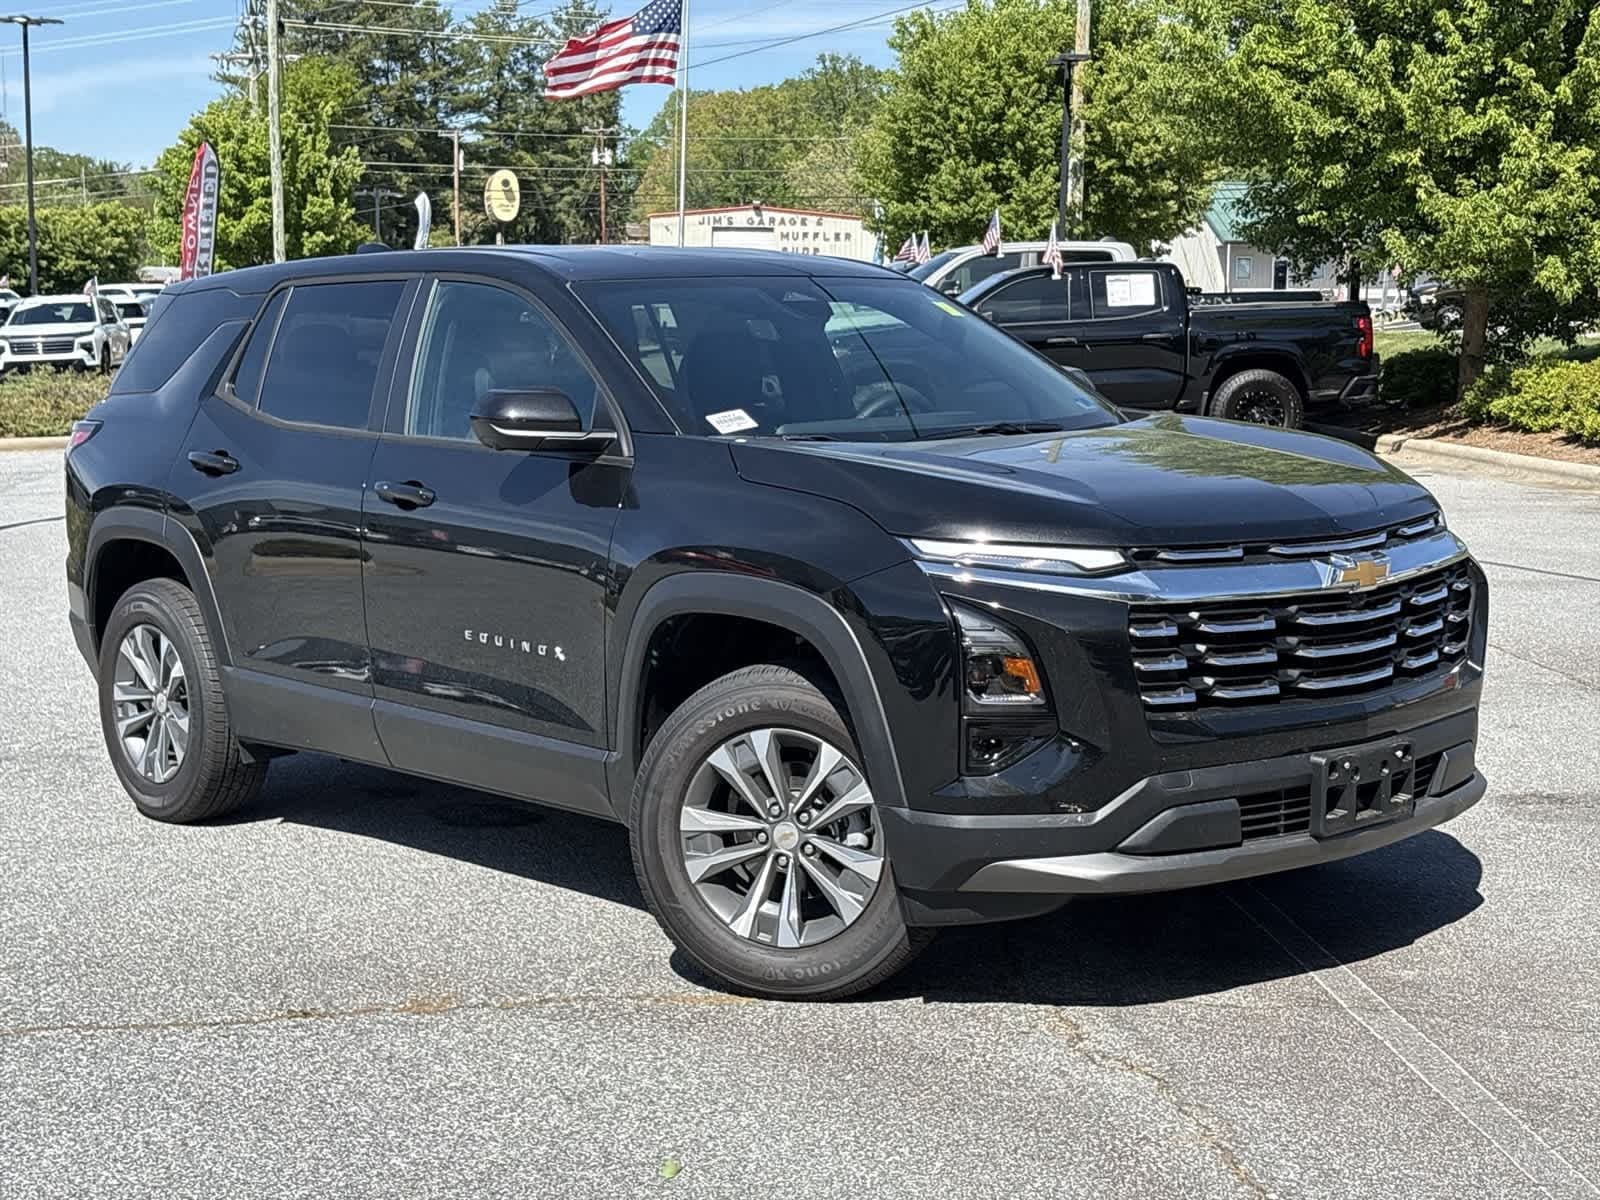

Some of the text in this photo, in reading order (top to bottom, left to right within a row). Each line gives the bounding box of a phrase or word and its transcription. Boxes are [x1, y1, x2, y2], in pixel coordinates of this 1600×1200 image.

[698, 215, 734, 226] JIM'S
[746, 216, 808, 227] GARAGE
[780, 231, 852, 242] MUFFLER
[464, 629, 566, 661] EQUINOX
